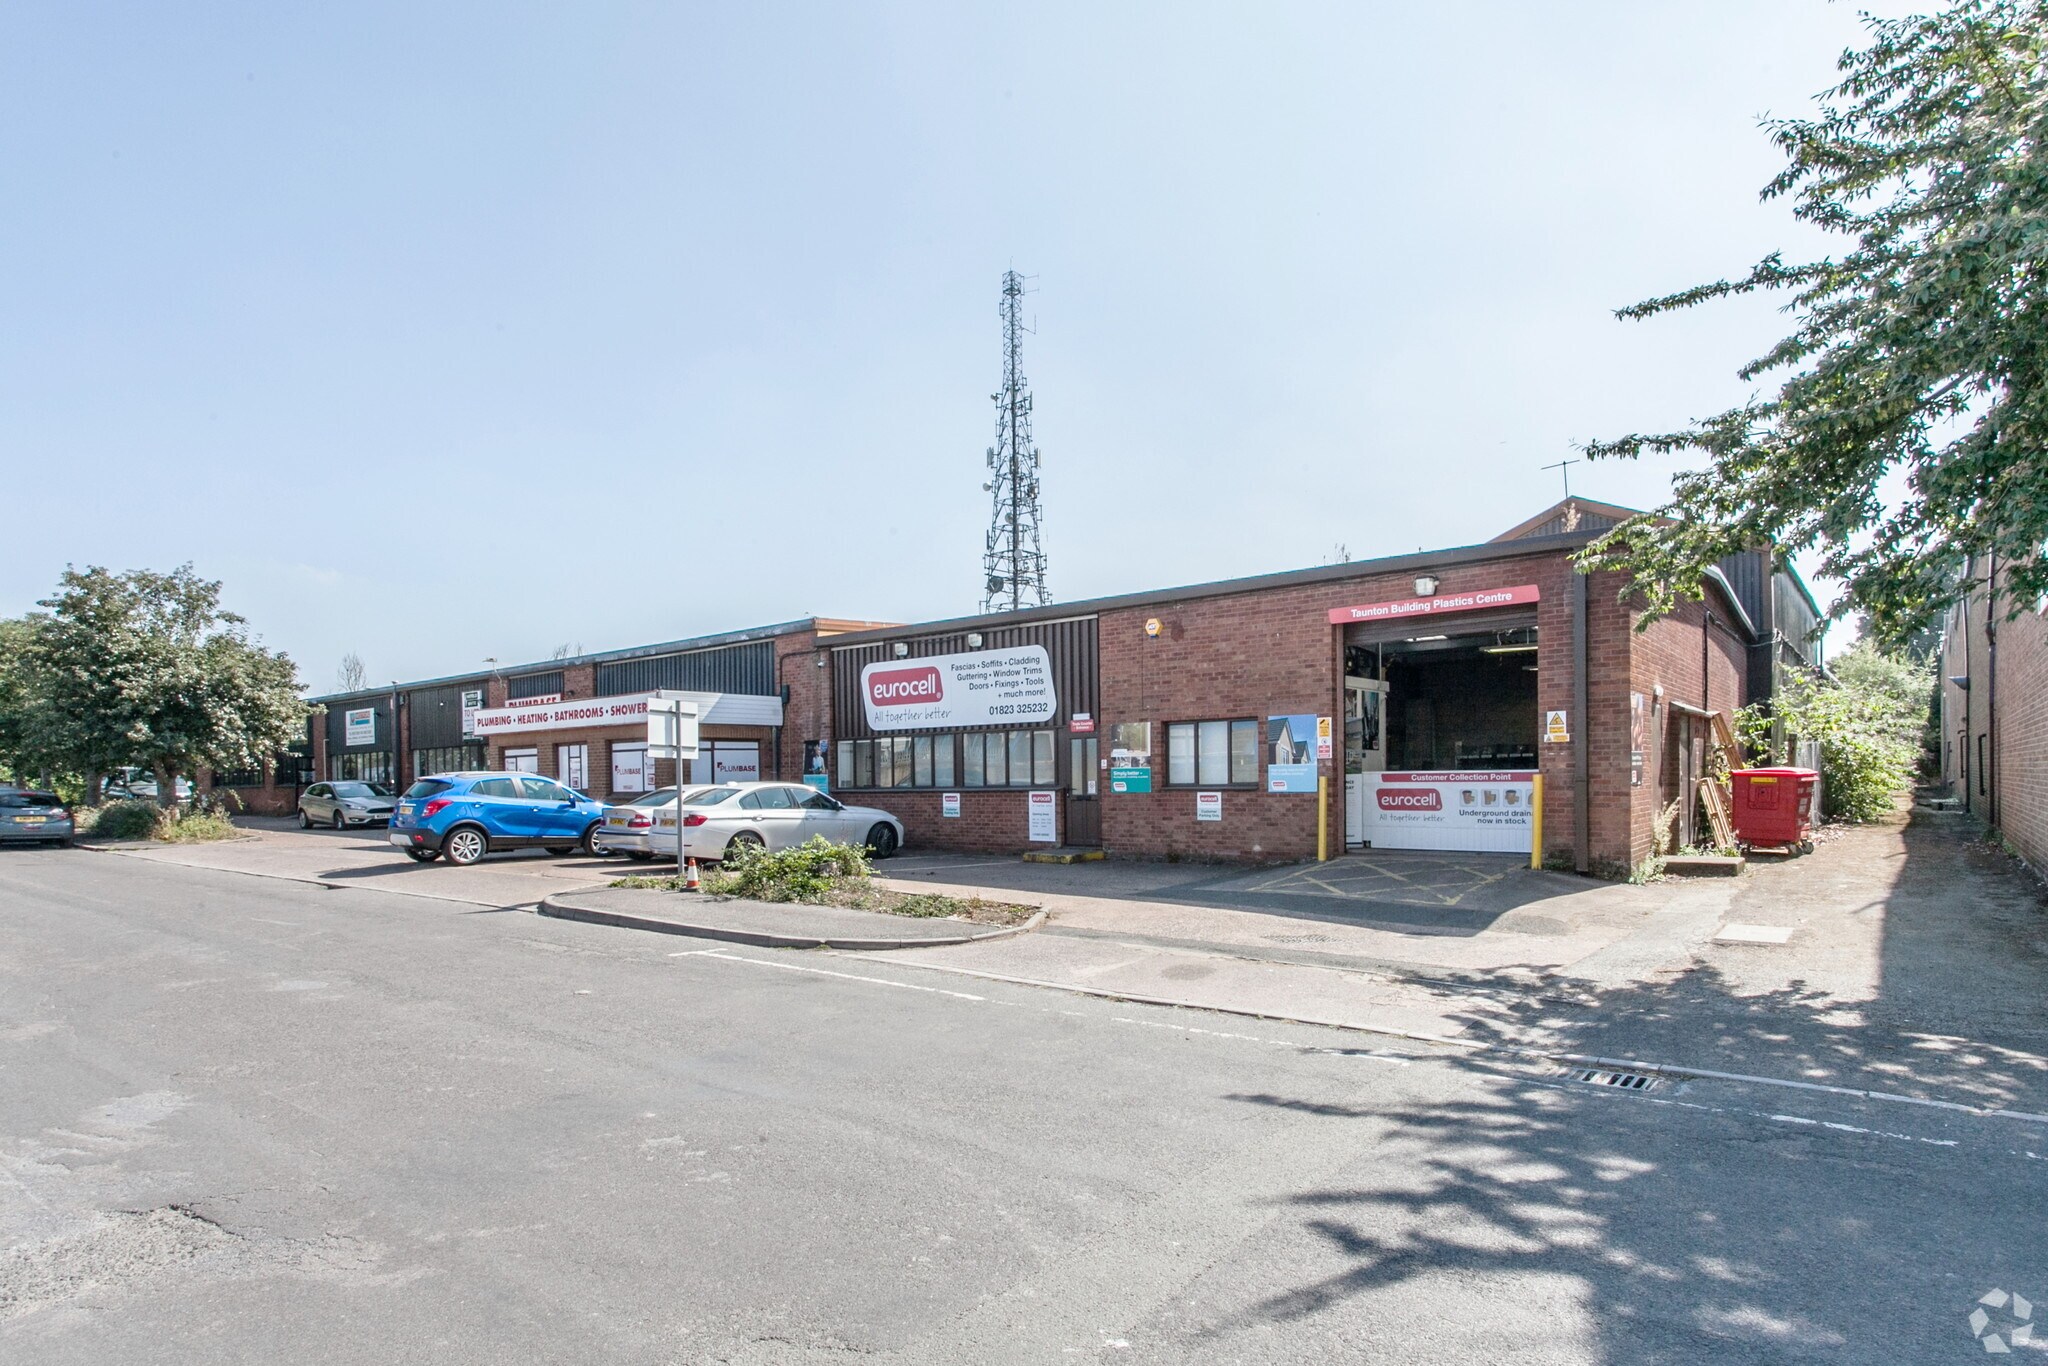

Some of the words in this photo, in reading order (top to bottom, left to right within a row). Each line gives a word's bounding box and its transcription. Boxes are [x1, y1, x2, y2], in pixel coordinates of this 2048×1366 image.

[1351, 607, 1388, 618] Taunton
[1391, 602, 1430, 613] Building
[1434, 597, 1473, 608] Plastics
[1476, 593, 1512, 603] Centre
[951, 662, 976, 671] Fascias
[981, 659, 1002, 668] Soffits
[1008, 656, 1040, 666] Cladding
[957, 672, 987, 681] Guttering
[993, 669, 1021, 677] Window
[874, 674, 936, 698] eurocell
[969, 682, 989, 690] Doors
[995, 680, 1019, 688] Fixings
[1004, 690, 1023, 698] much
[1025, 688, 1046, 697] more!
[874, 711, 883, 723] All
[886, 709, 922, 723] together
[925, 706, 952, 720] better
[989, 705, 1014, 715] 01823
[1016, 703, 1048, 713] 325232
[477, 716, 511, 727] PLUMBING
[517, 713, 548, 724] HEATING
[554, 707, 604, 721] BATHROOMS
[1381, 793, 1436, 806] eurocell
[1390, 813, 1420, 822] together
